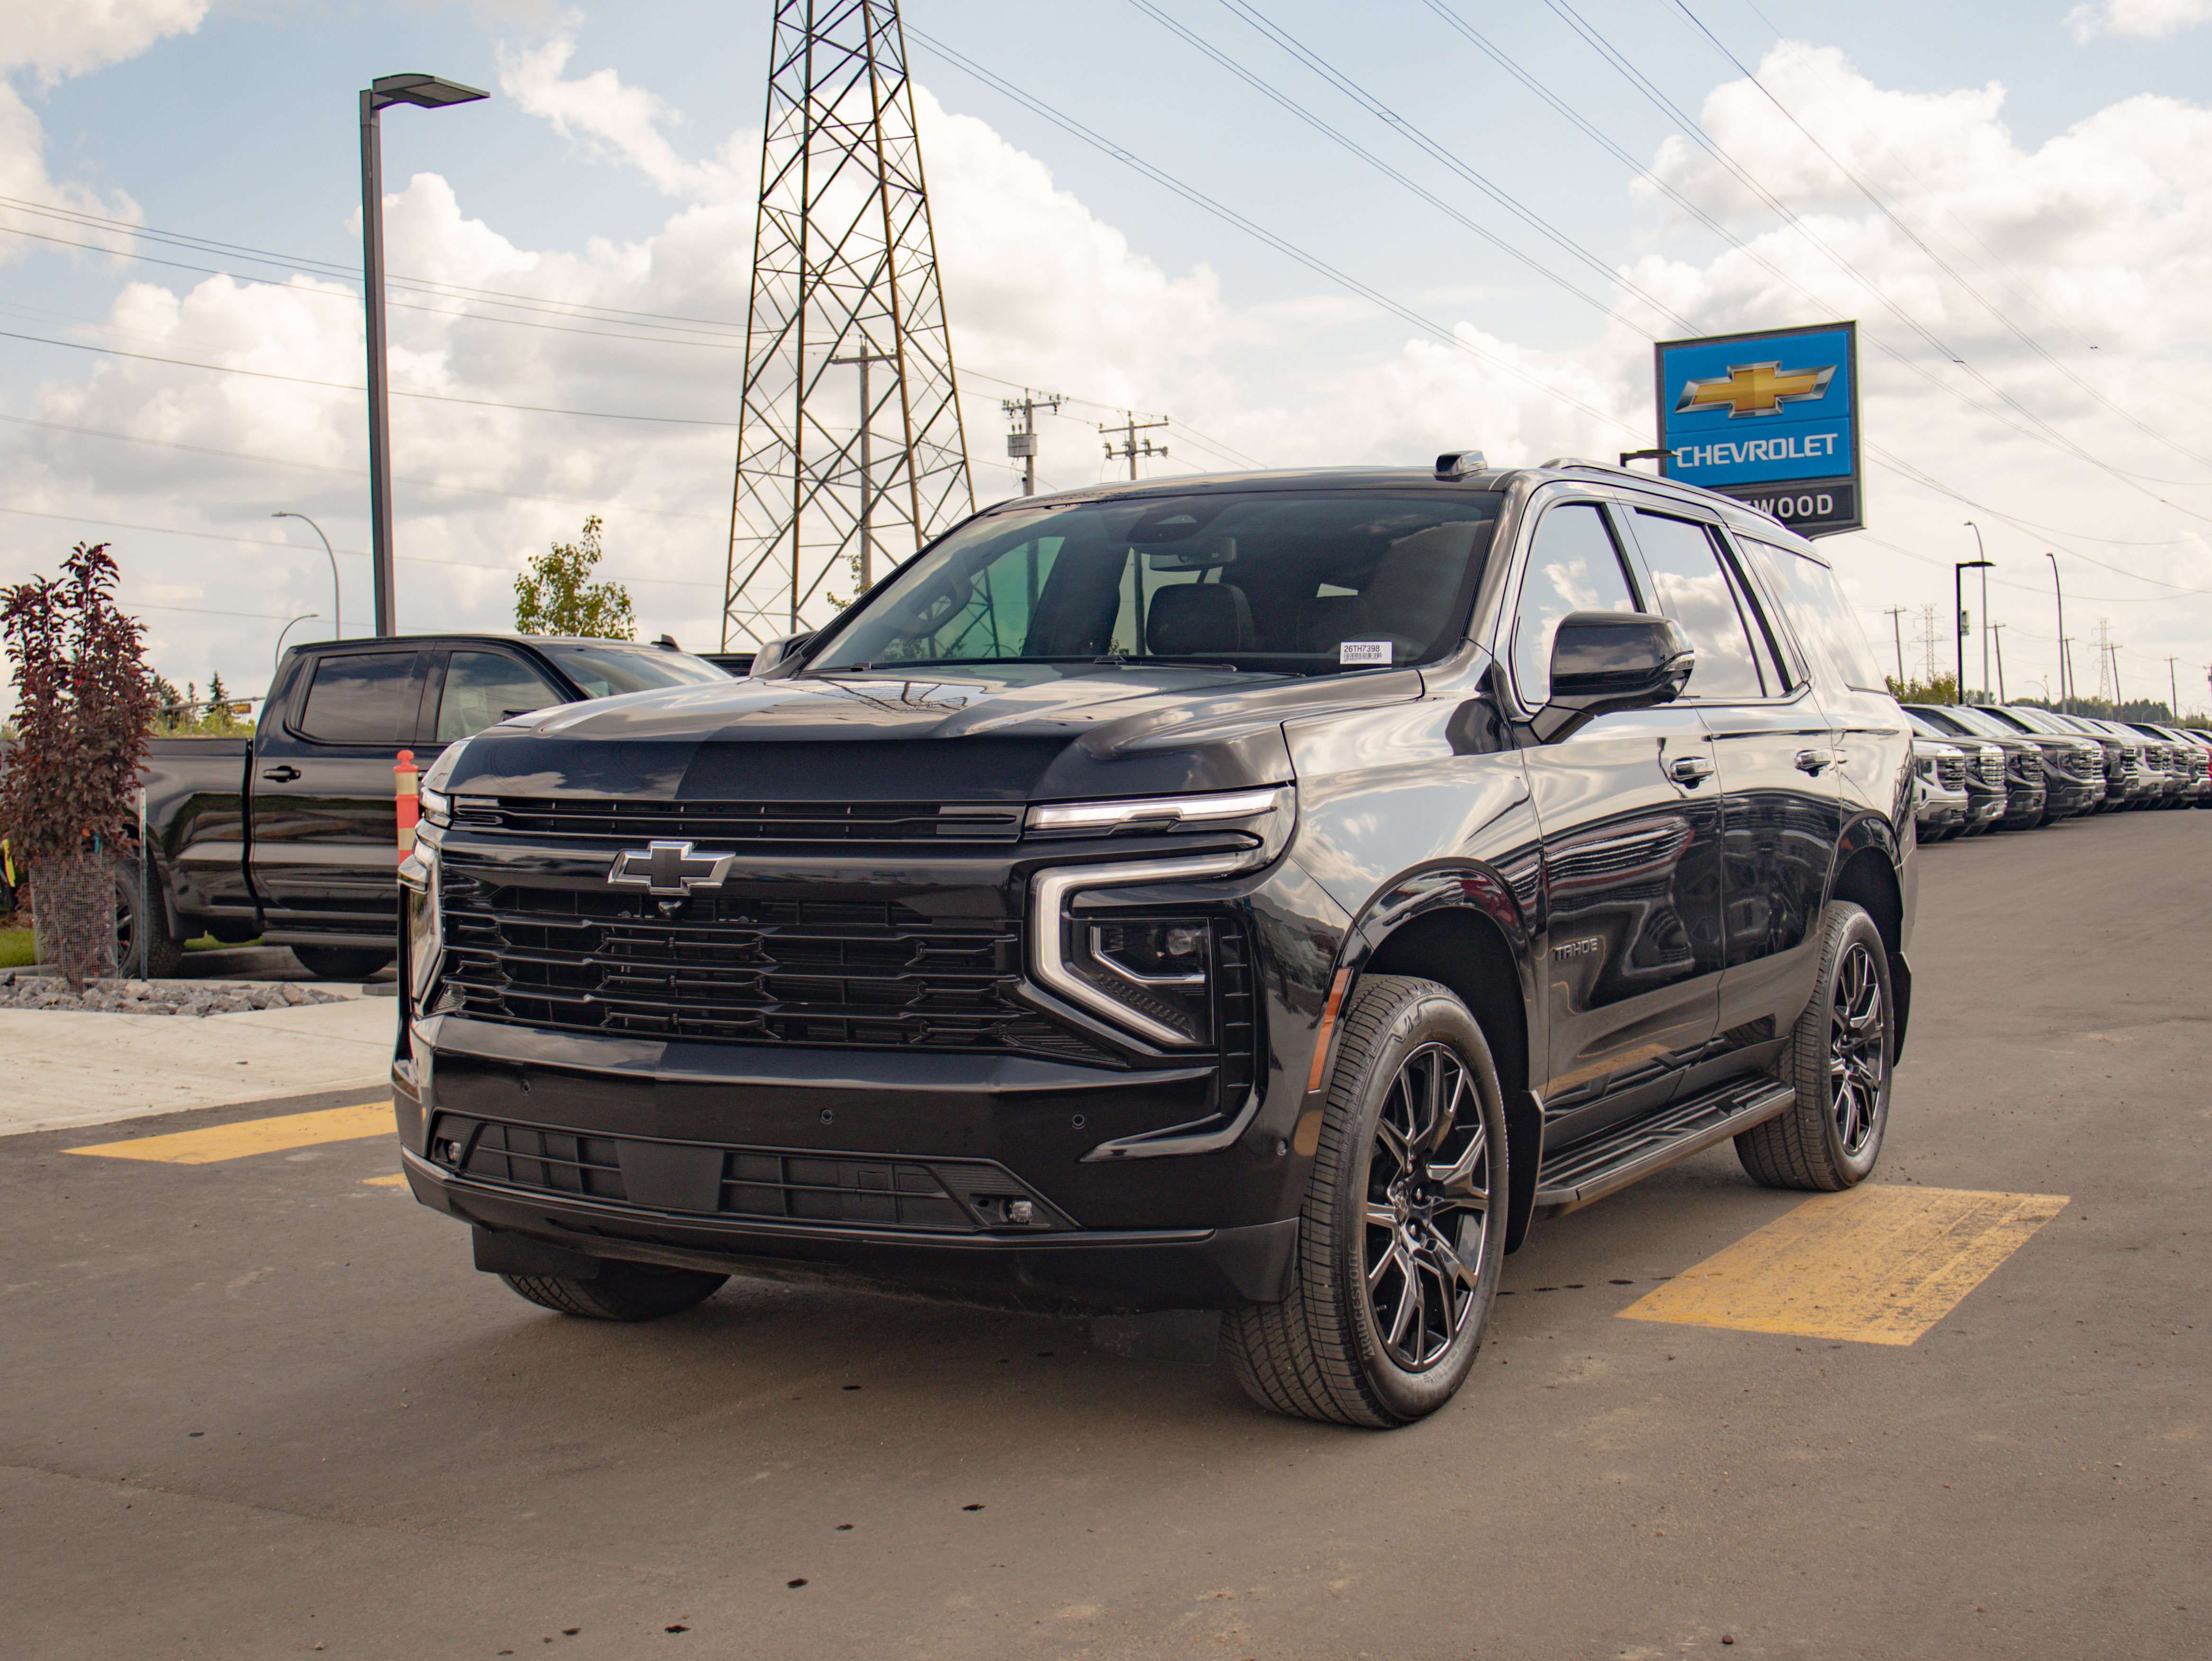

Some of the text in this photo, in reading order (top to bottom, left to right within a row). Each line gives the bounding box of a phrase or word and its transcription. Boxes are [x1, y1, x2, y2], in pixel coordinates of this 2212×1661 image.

[1676, 433, 1838, 468] CHEVROLET
[1741, 494, 1833, 518] WOOD
[1553, 938, 1598, 960] TAHOE
[1348, 1243, 1375, 1360] BRIDGESTONE
